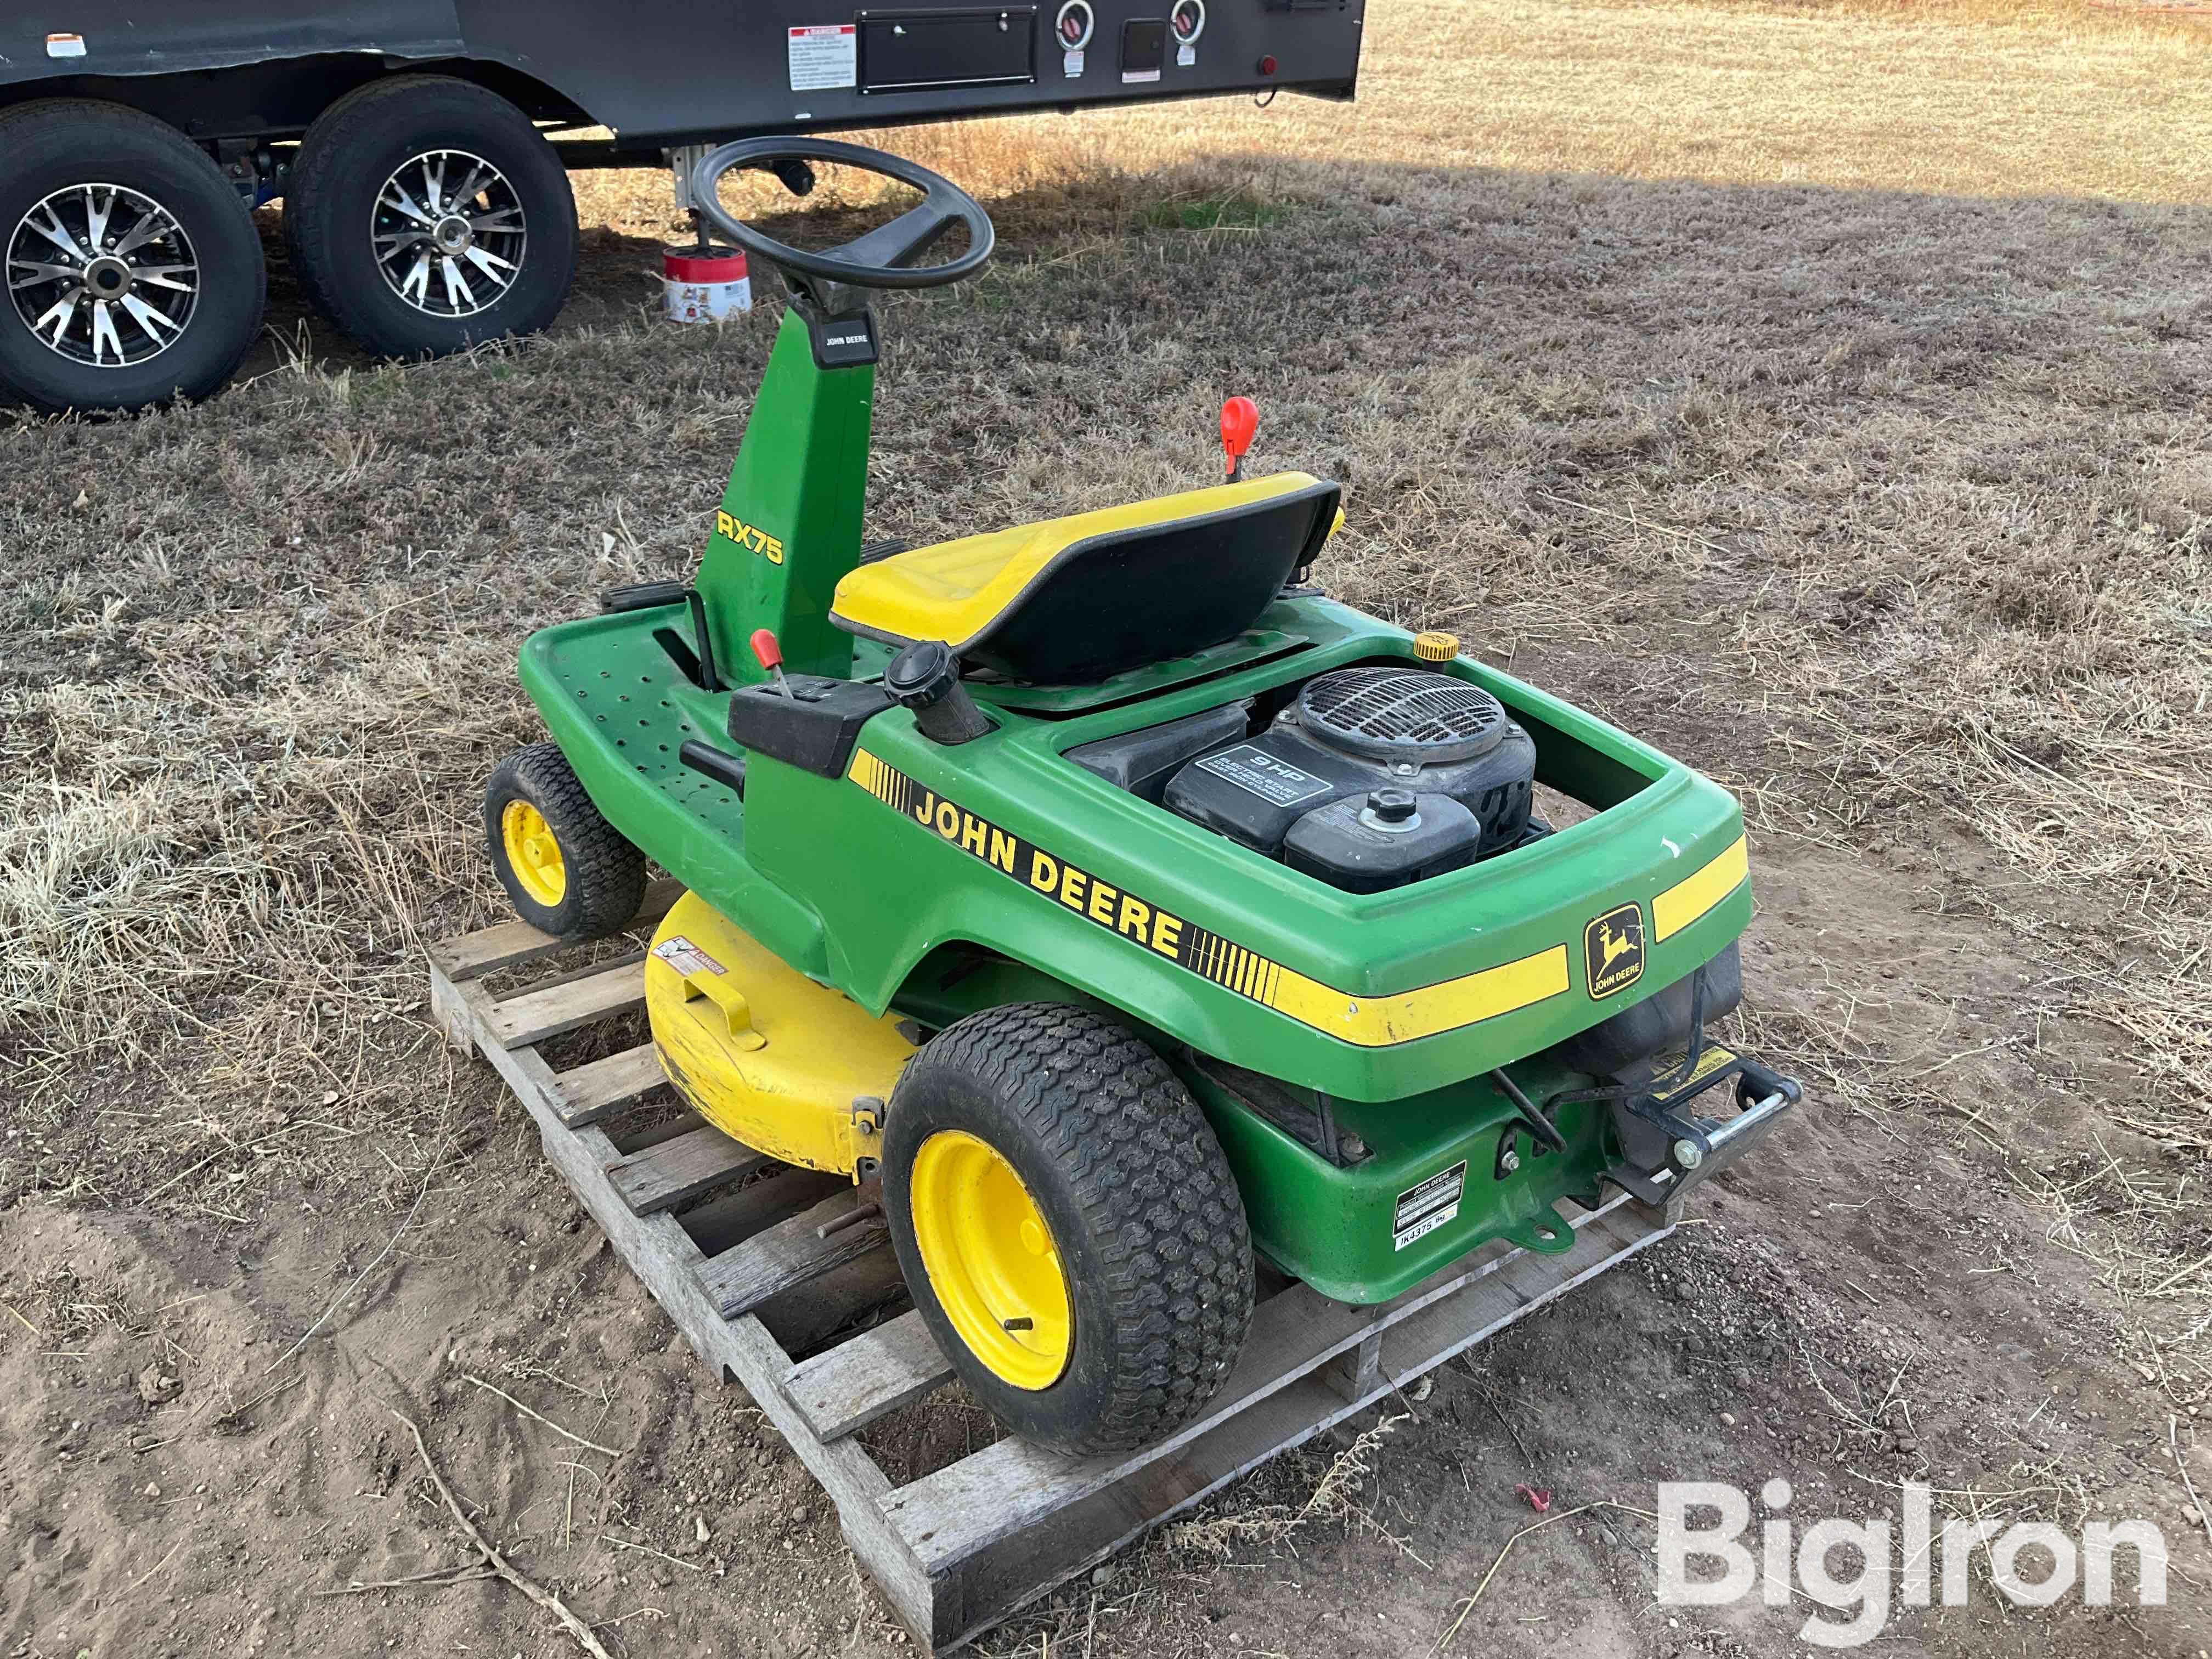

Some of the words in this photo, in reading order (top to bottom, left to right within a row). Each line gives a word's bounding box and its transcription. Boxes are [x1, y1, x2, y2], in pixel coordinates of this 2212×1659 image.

[827, 337, 844, 346] JOHN
[845, 335, 868, 343] DEERE
[717, 509, 783, 565] RX75
[1207, 761, 1229, 772] CAST
[1228, 772, 1248, 782] IRON
[1247, 781, 1285, 801] CYLINDER
[1214, 760, 1238, 772] OVER
[1238, 771, 1263, 785] HEAD
[1264, 783, 1293, 799] VALVE
[1219, 757, 1265, 779] ELECTRIC
[1265, 778, 1299, 795] START
[1250, 757, 1271, 766] 9
[1266, 764, 1305, 781] HP
[916, 792, 1016, 873] JOHN
[1030, 850, 1183, 959] DEERE
[695, 952, 725, 975] DANGER
[1594, 974, 1615, 992] JOHN
[1616, 962, 1640, 981] DEERE
[1414, 1183, 1430, 1196] JOHN
[1431, 1171, 1451, 1187] DEERE
